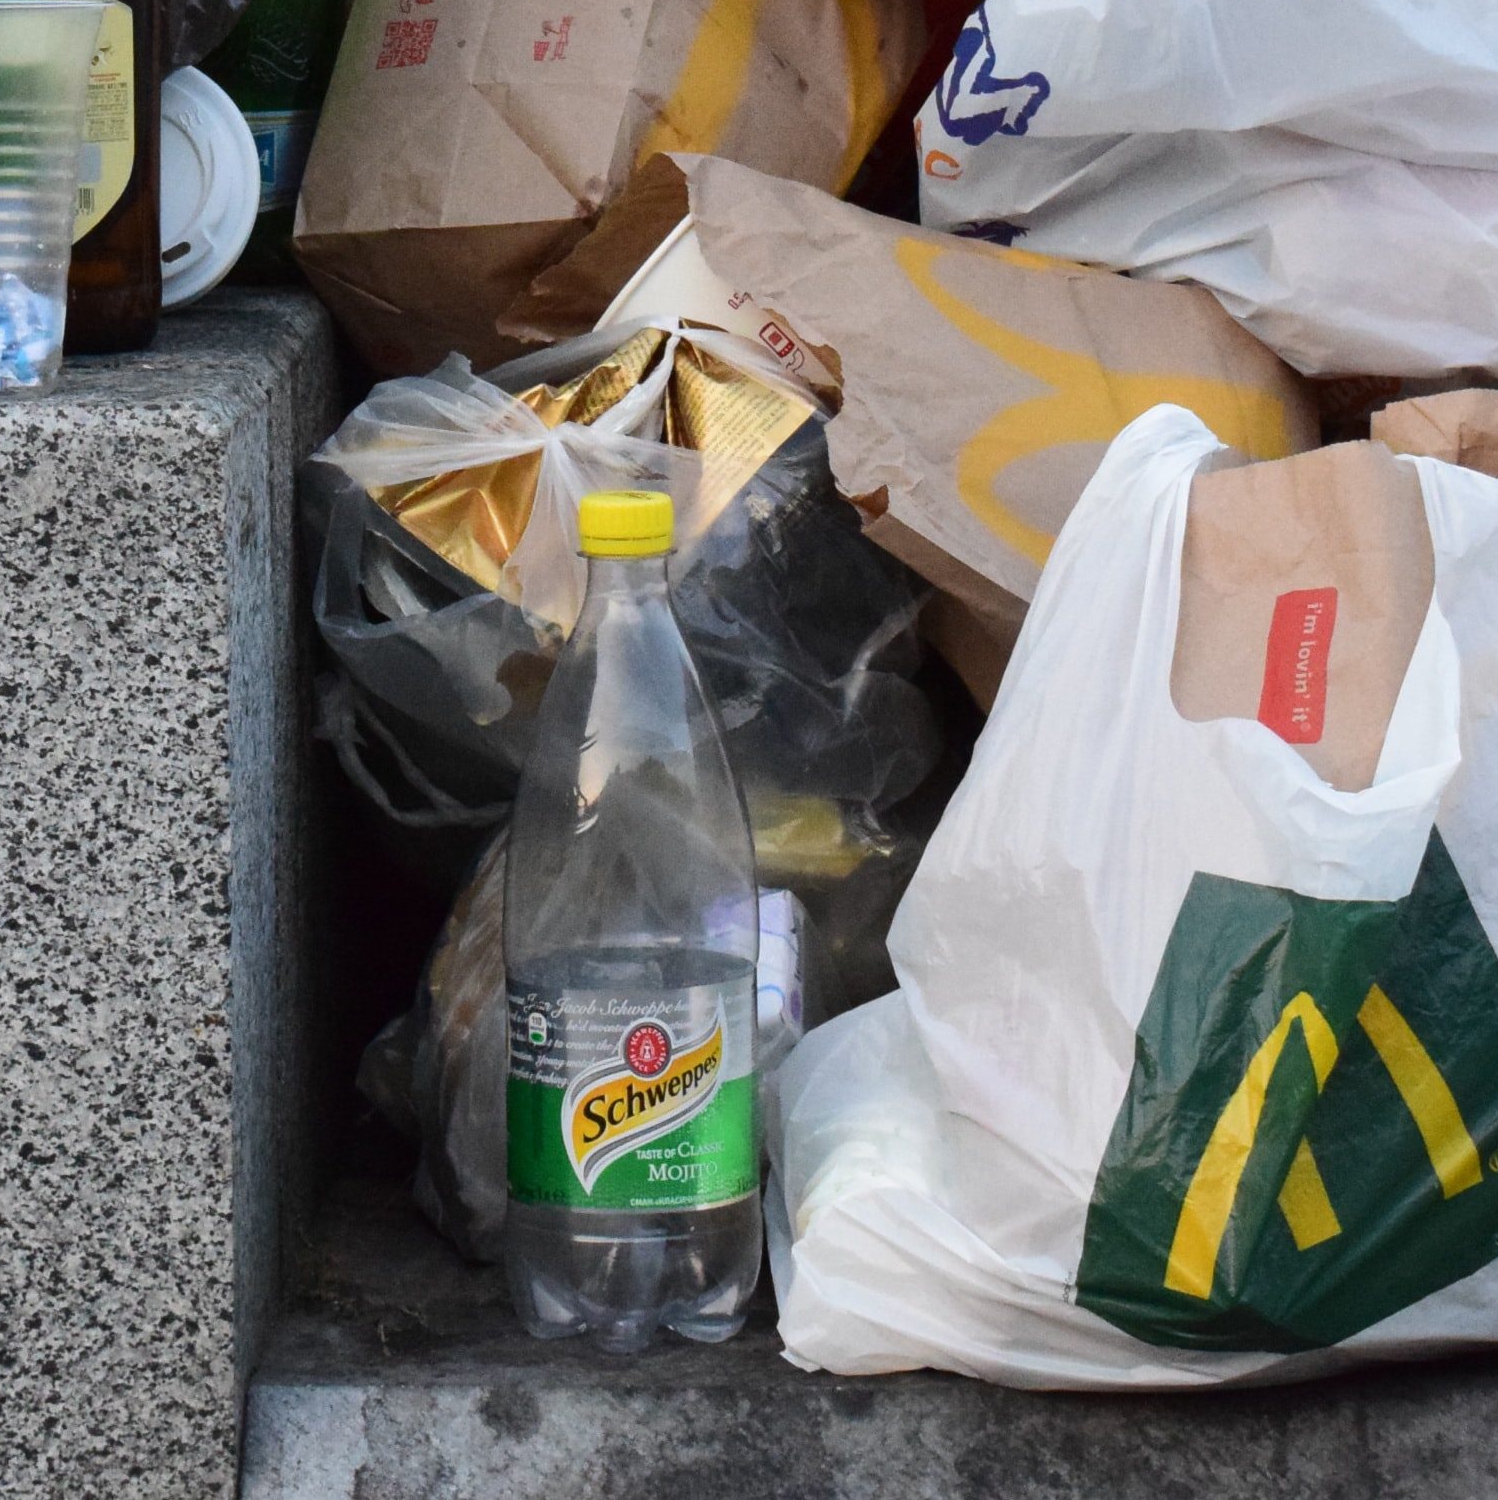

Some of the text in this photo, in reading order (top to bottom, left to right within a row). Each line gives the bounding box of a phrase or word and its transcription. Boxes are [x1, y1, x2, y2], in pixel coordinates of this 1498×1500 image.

[1291, 602, 1323, 723] i'm lovin' it
[551, 997, 597, 1019] Jacob
[600, 998, 674, 1017] Schweppe
[582, 1053, 719, 1144] Schweppes
[636, 1149, 664, 1161] TASTE
[664, 1148, 676, 1159] OF
